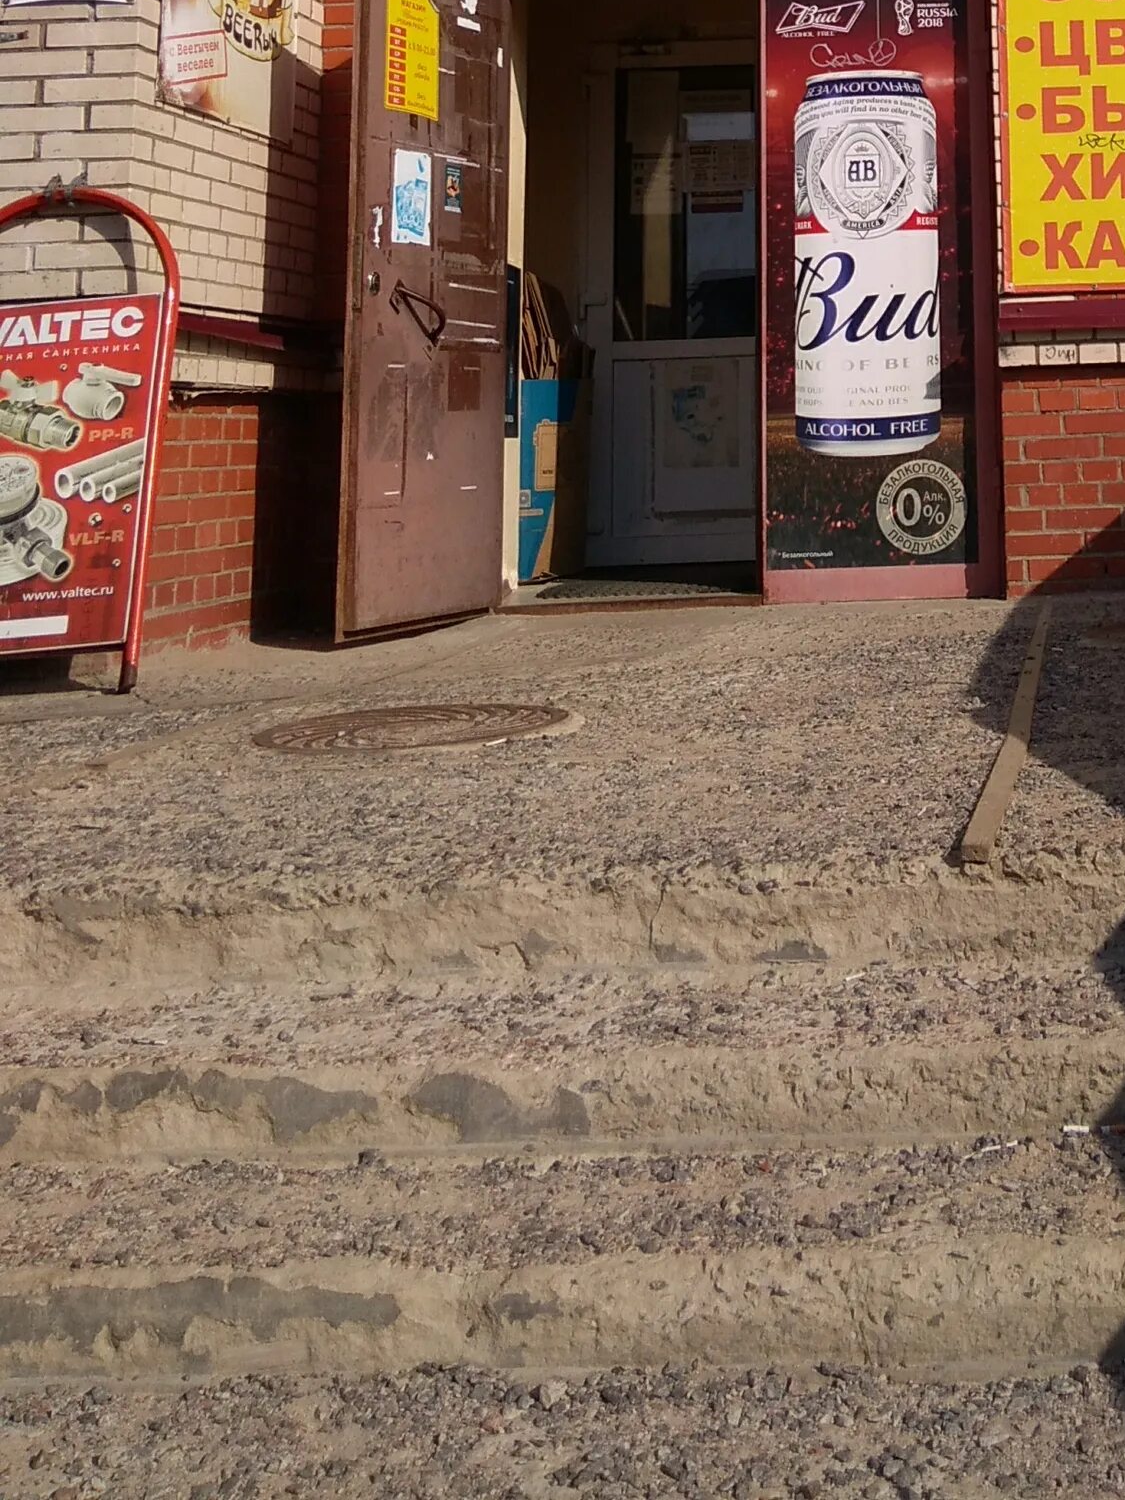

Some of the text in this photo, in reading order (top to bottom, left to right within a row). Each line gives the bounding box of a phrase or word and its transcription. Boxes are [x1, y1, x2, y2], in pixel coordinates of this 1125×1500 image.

[792, 5, 841, 24] Bud
[917, 8, 958, 18] RUSSIA
[917, 18, 943, 28] 2018
[177, 58, 214, 72] веселее
[851, 105, 867, 114] find
[848, 159, 876, 182] AB
[845, 220, 881, 229] AMERICA
[795, 251, 940, 351] Bud
[0, 343, 140, 362] НАЯ САНТЕХНИКА
[88, 426, 134, 442] PP-R
[805, 418, 929, 436] ALCOHOL FREE
[878, 462, 966, 505] БЕЗАЛКОГОЛЬНАЯ
[69, 529, 125, 547] VLF-R
[888, 524, 959, 554] ПРОДУКЦИЯ
[22, 585, 114, 602] www.valtec.ru
